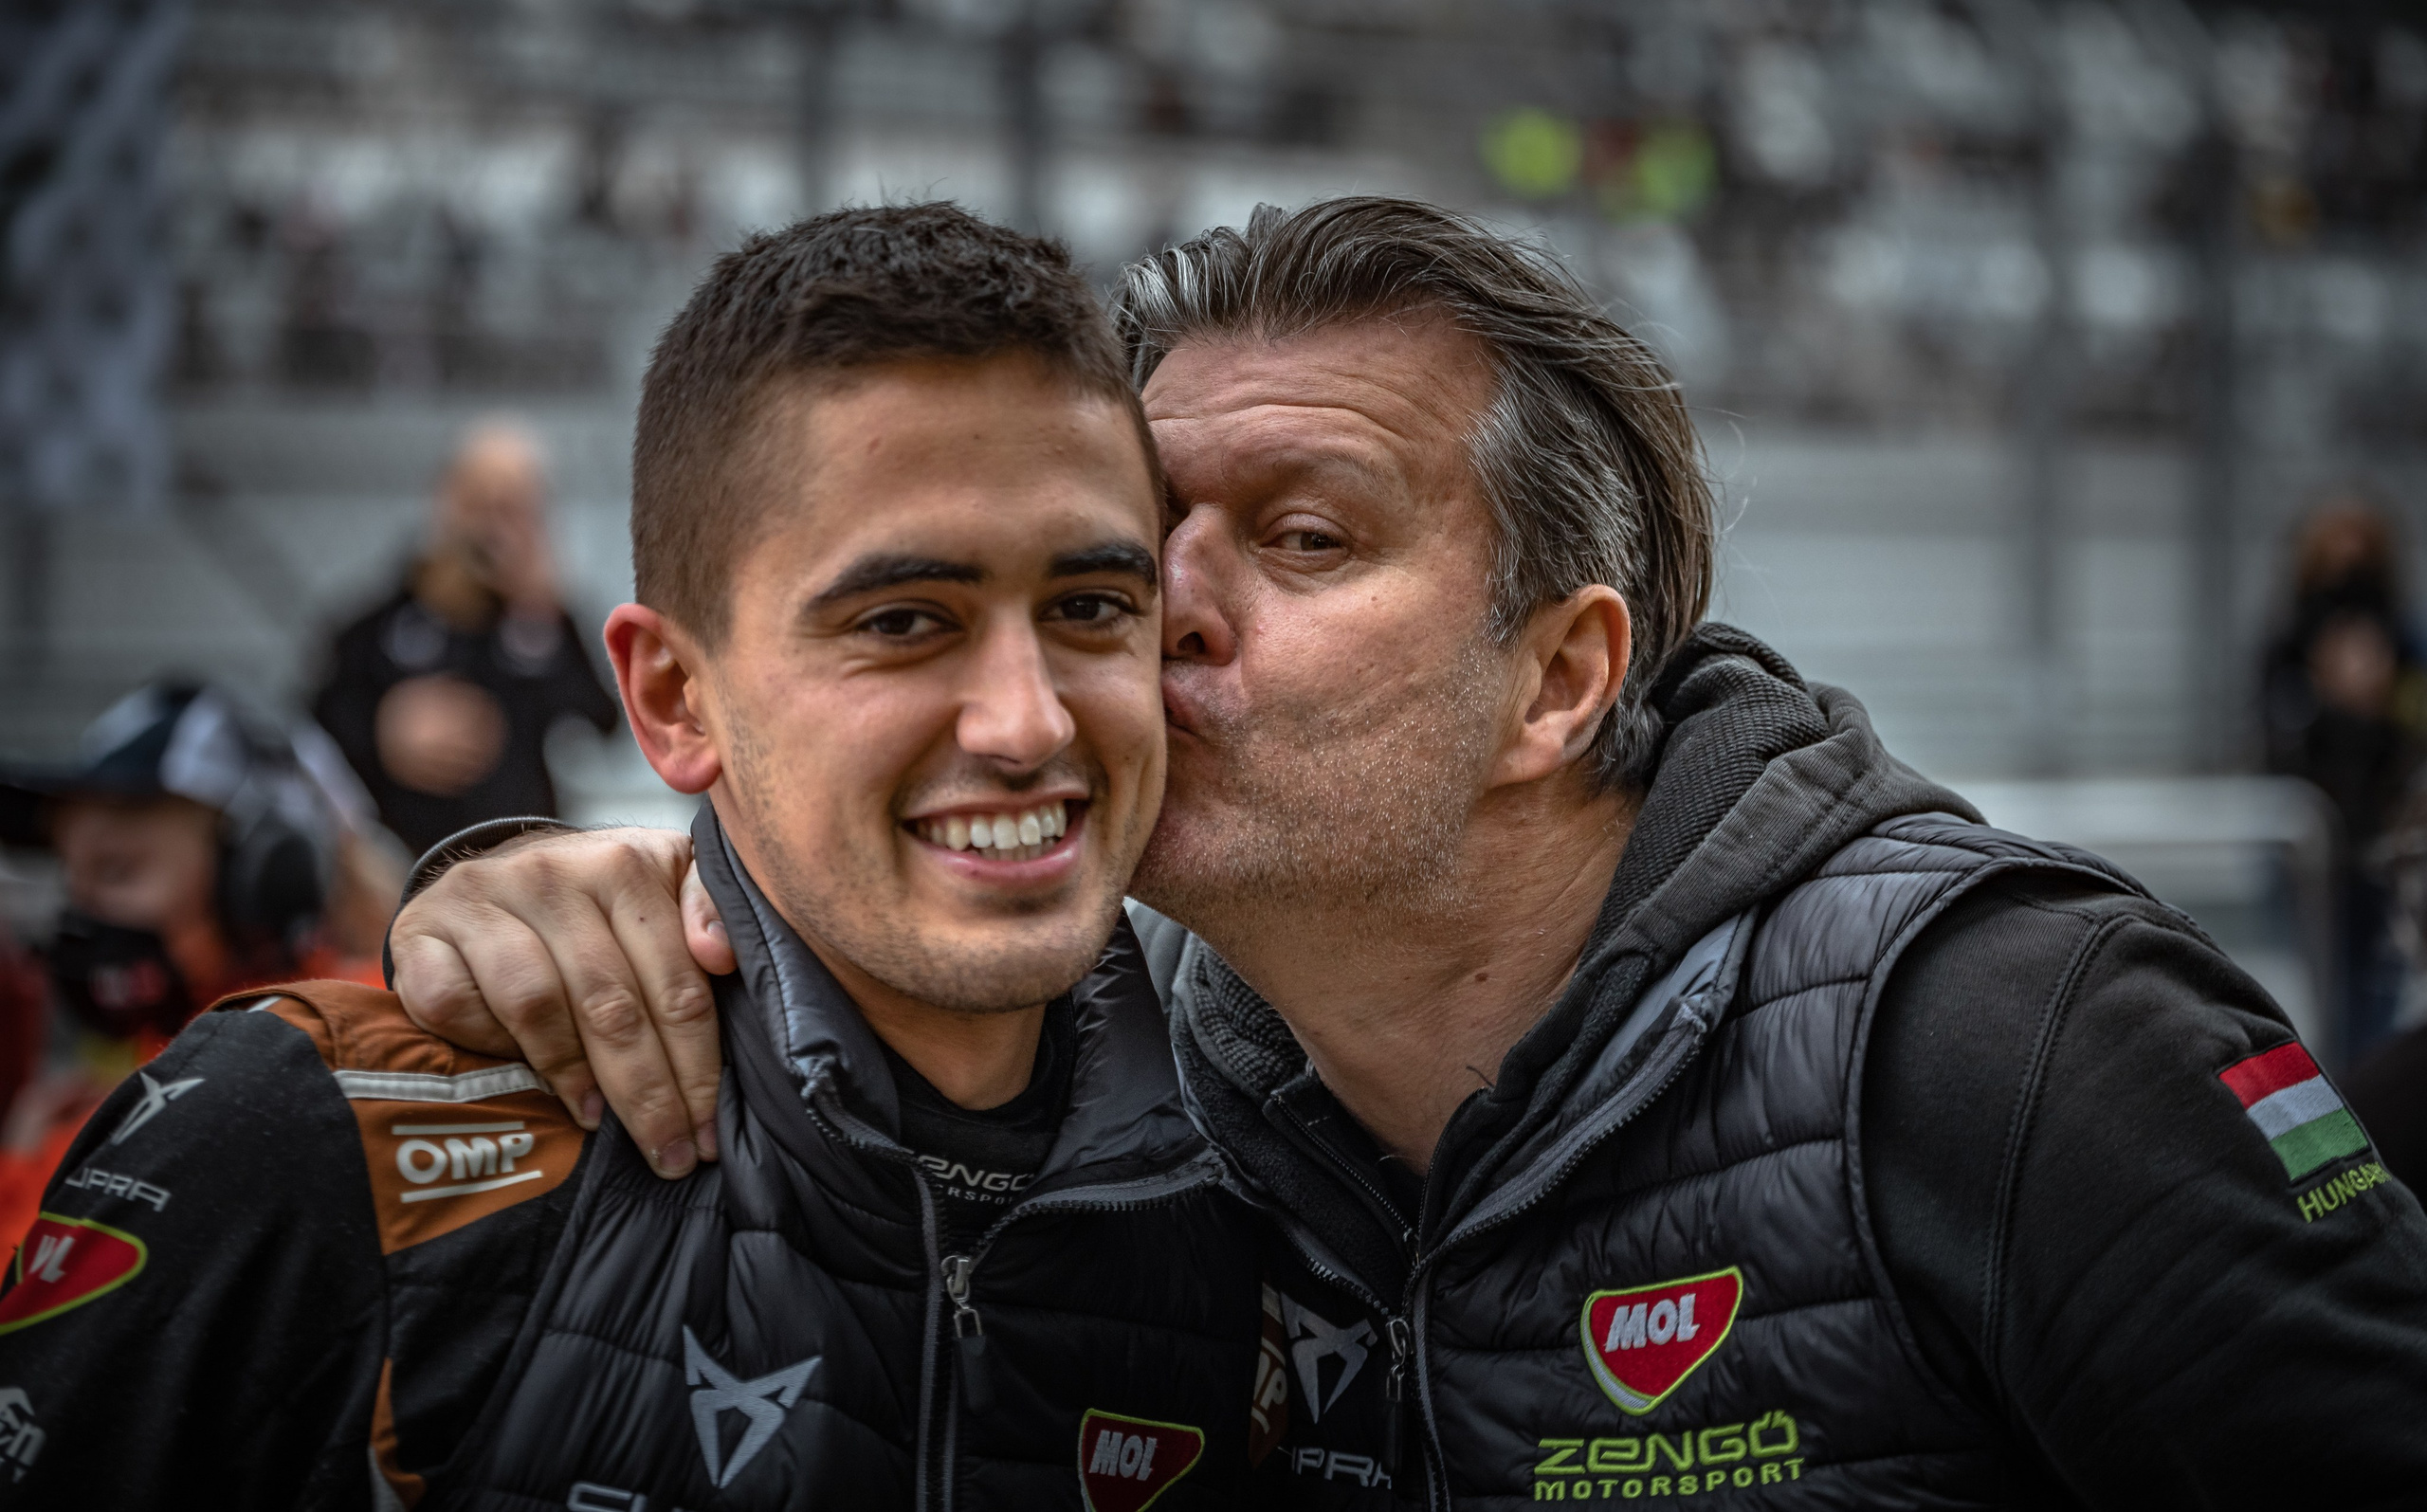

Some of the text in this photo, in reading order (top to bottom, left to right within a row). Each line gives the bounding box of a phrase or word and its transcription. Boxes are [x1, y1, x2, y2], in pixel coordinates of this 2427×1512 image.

[395, 1132, 535, 1185] OMP
[1605, 1293, 1700, 1353] MOL
[1088, 1429, 1159, 1482] MOL
[1534, 1457, 1805, 1502] MOTORSPORT
